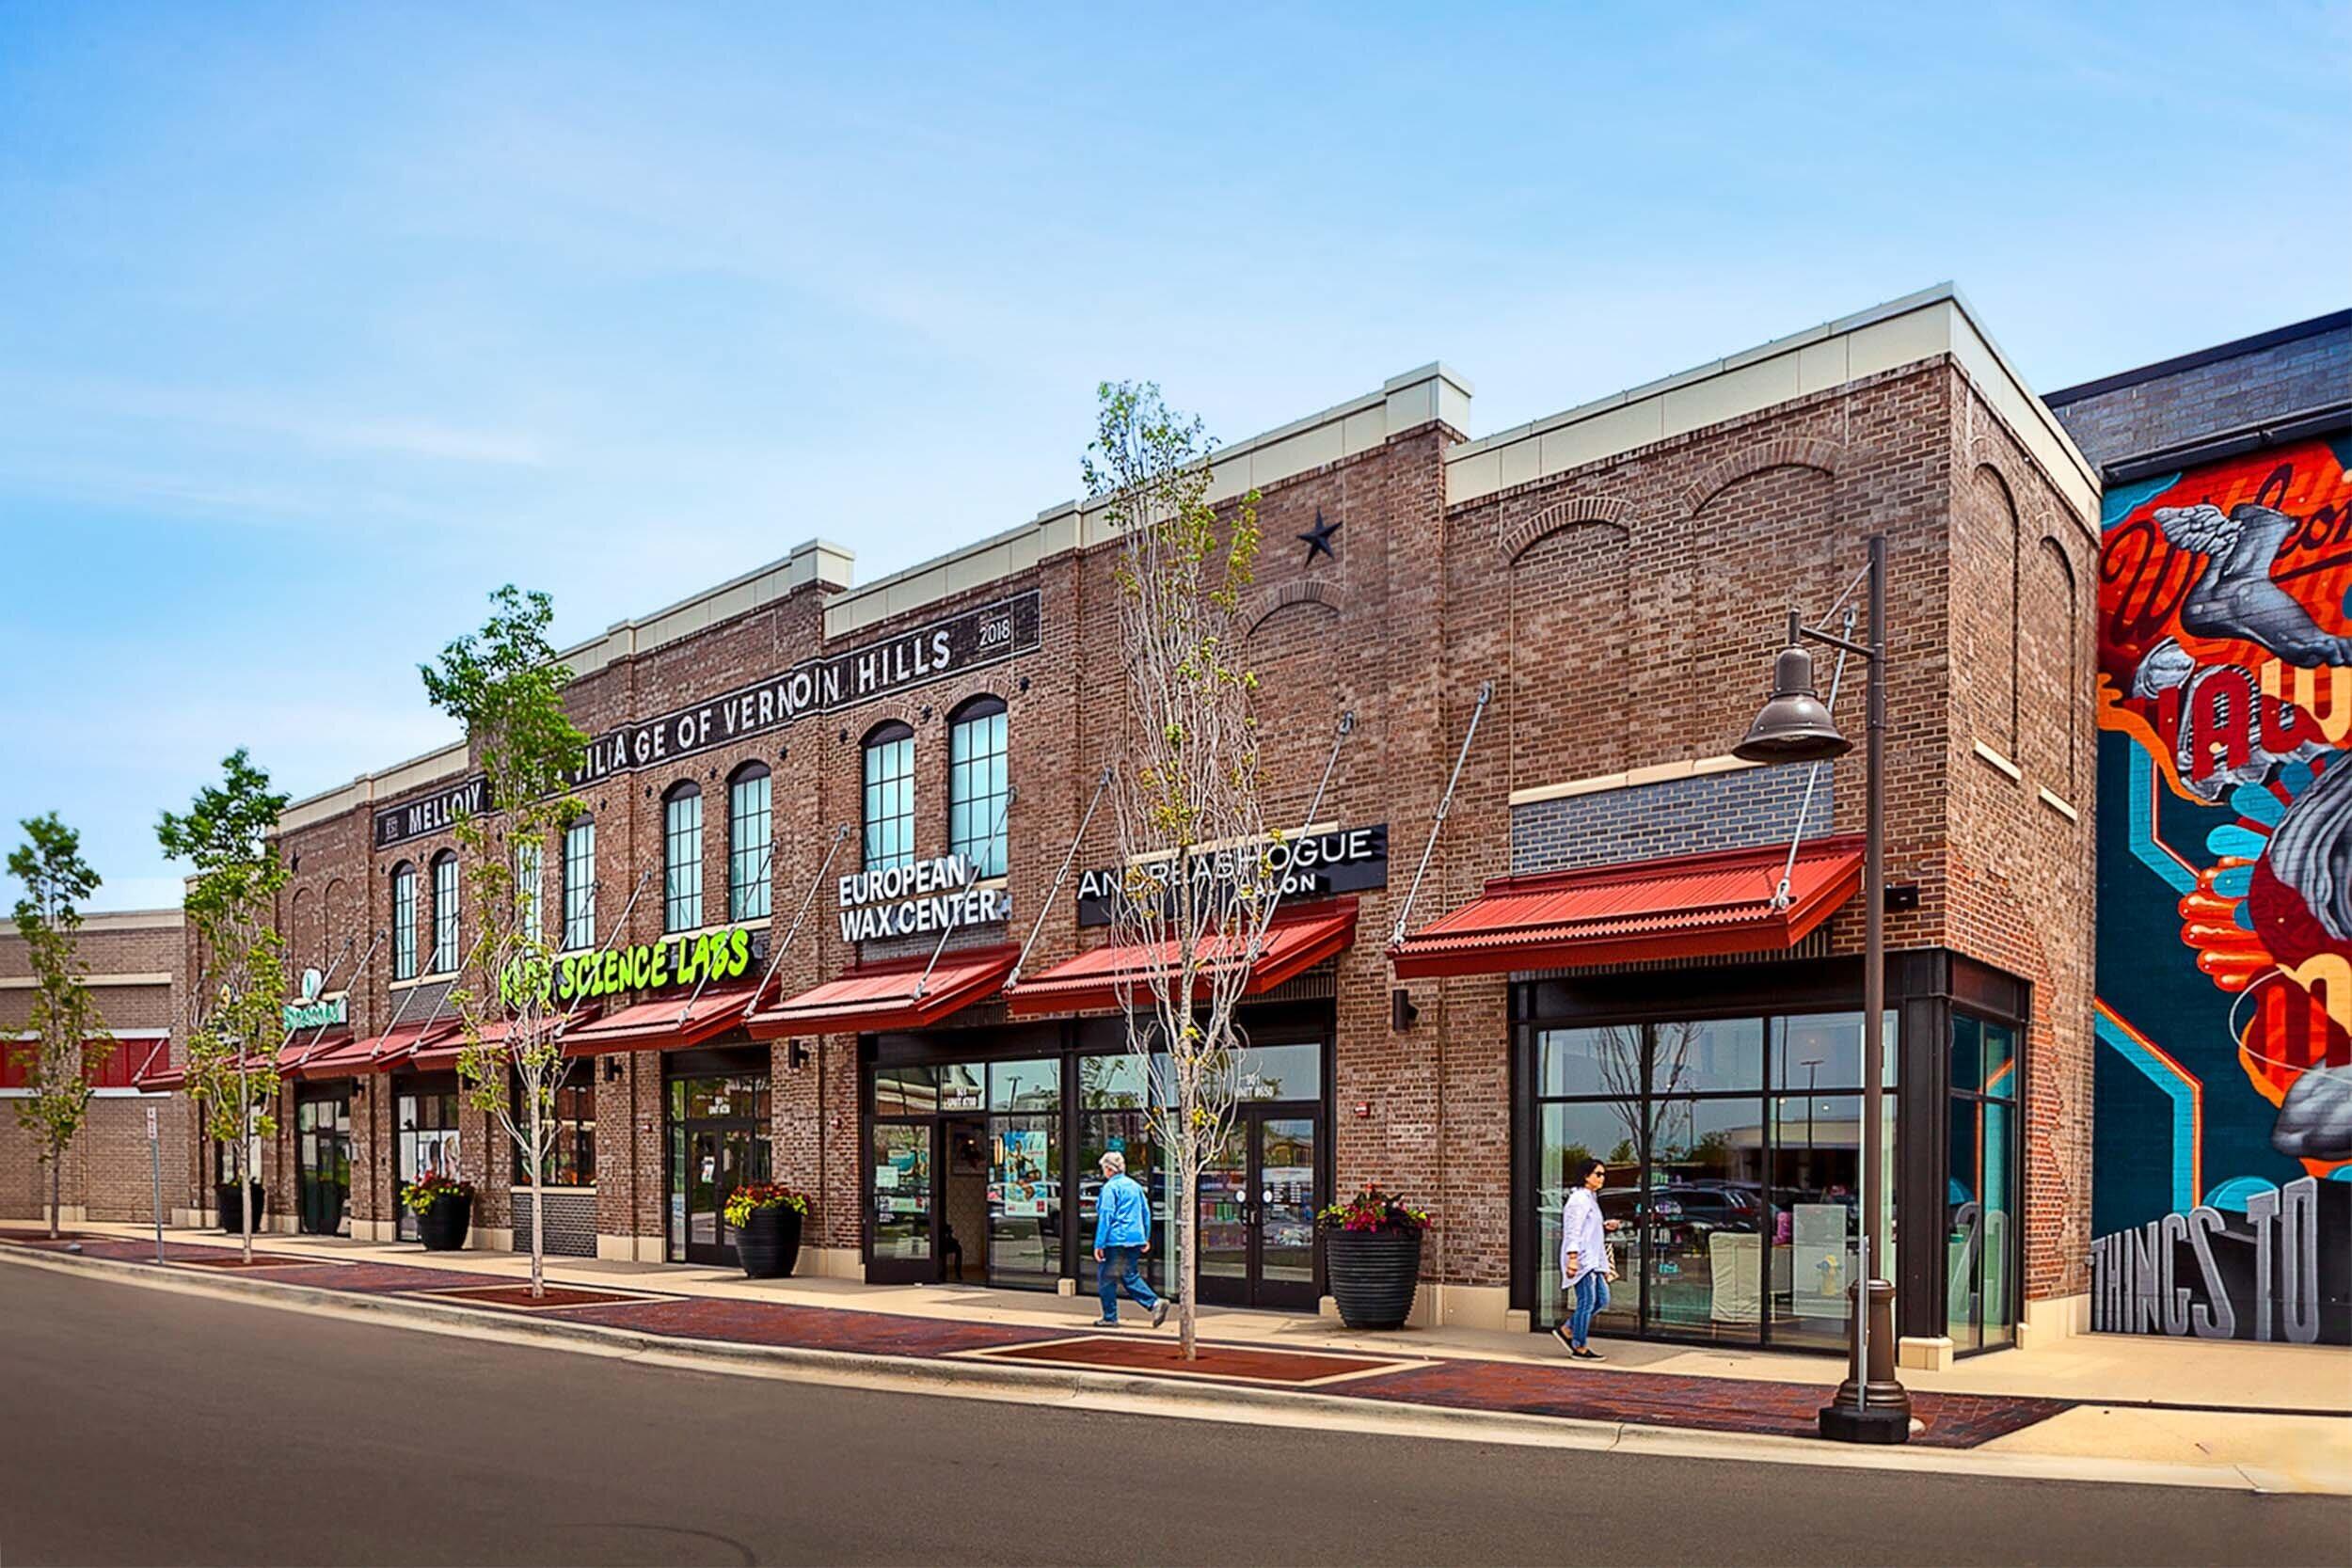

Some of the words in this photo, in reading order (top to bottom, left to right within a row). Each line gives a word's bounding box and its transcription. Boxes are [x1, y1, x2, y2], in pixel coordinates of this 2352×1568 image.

[409, 783, 481, 834] MELLOY
[677, 706, 712, 749] OF
[858, 629, 950, 693] HILLS
[979, 618, 1011, 647] 2018
[838, 852, 967, 908] EUROPEAN
[1236, 830, 1374, 876] HOGUE
[839, 904, 894, 942] WAX
[898, 889, 996, 934] CENTER
[559, 942, 668, 1000] SCIENCE
[676, 927, 749, 985] LABS
[2091, 1207, 2235, 1339] THINGS
[2247, 1176, 2318, 1344] TO
